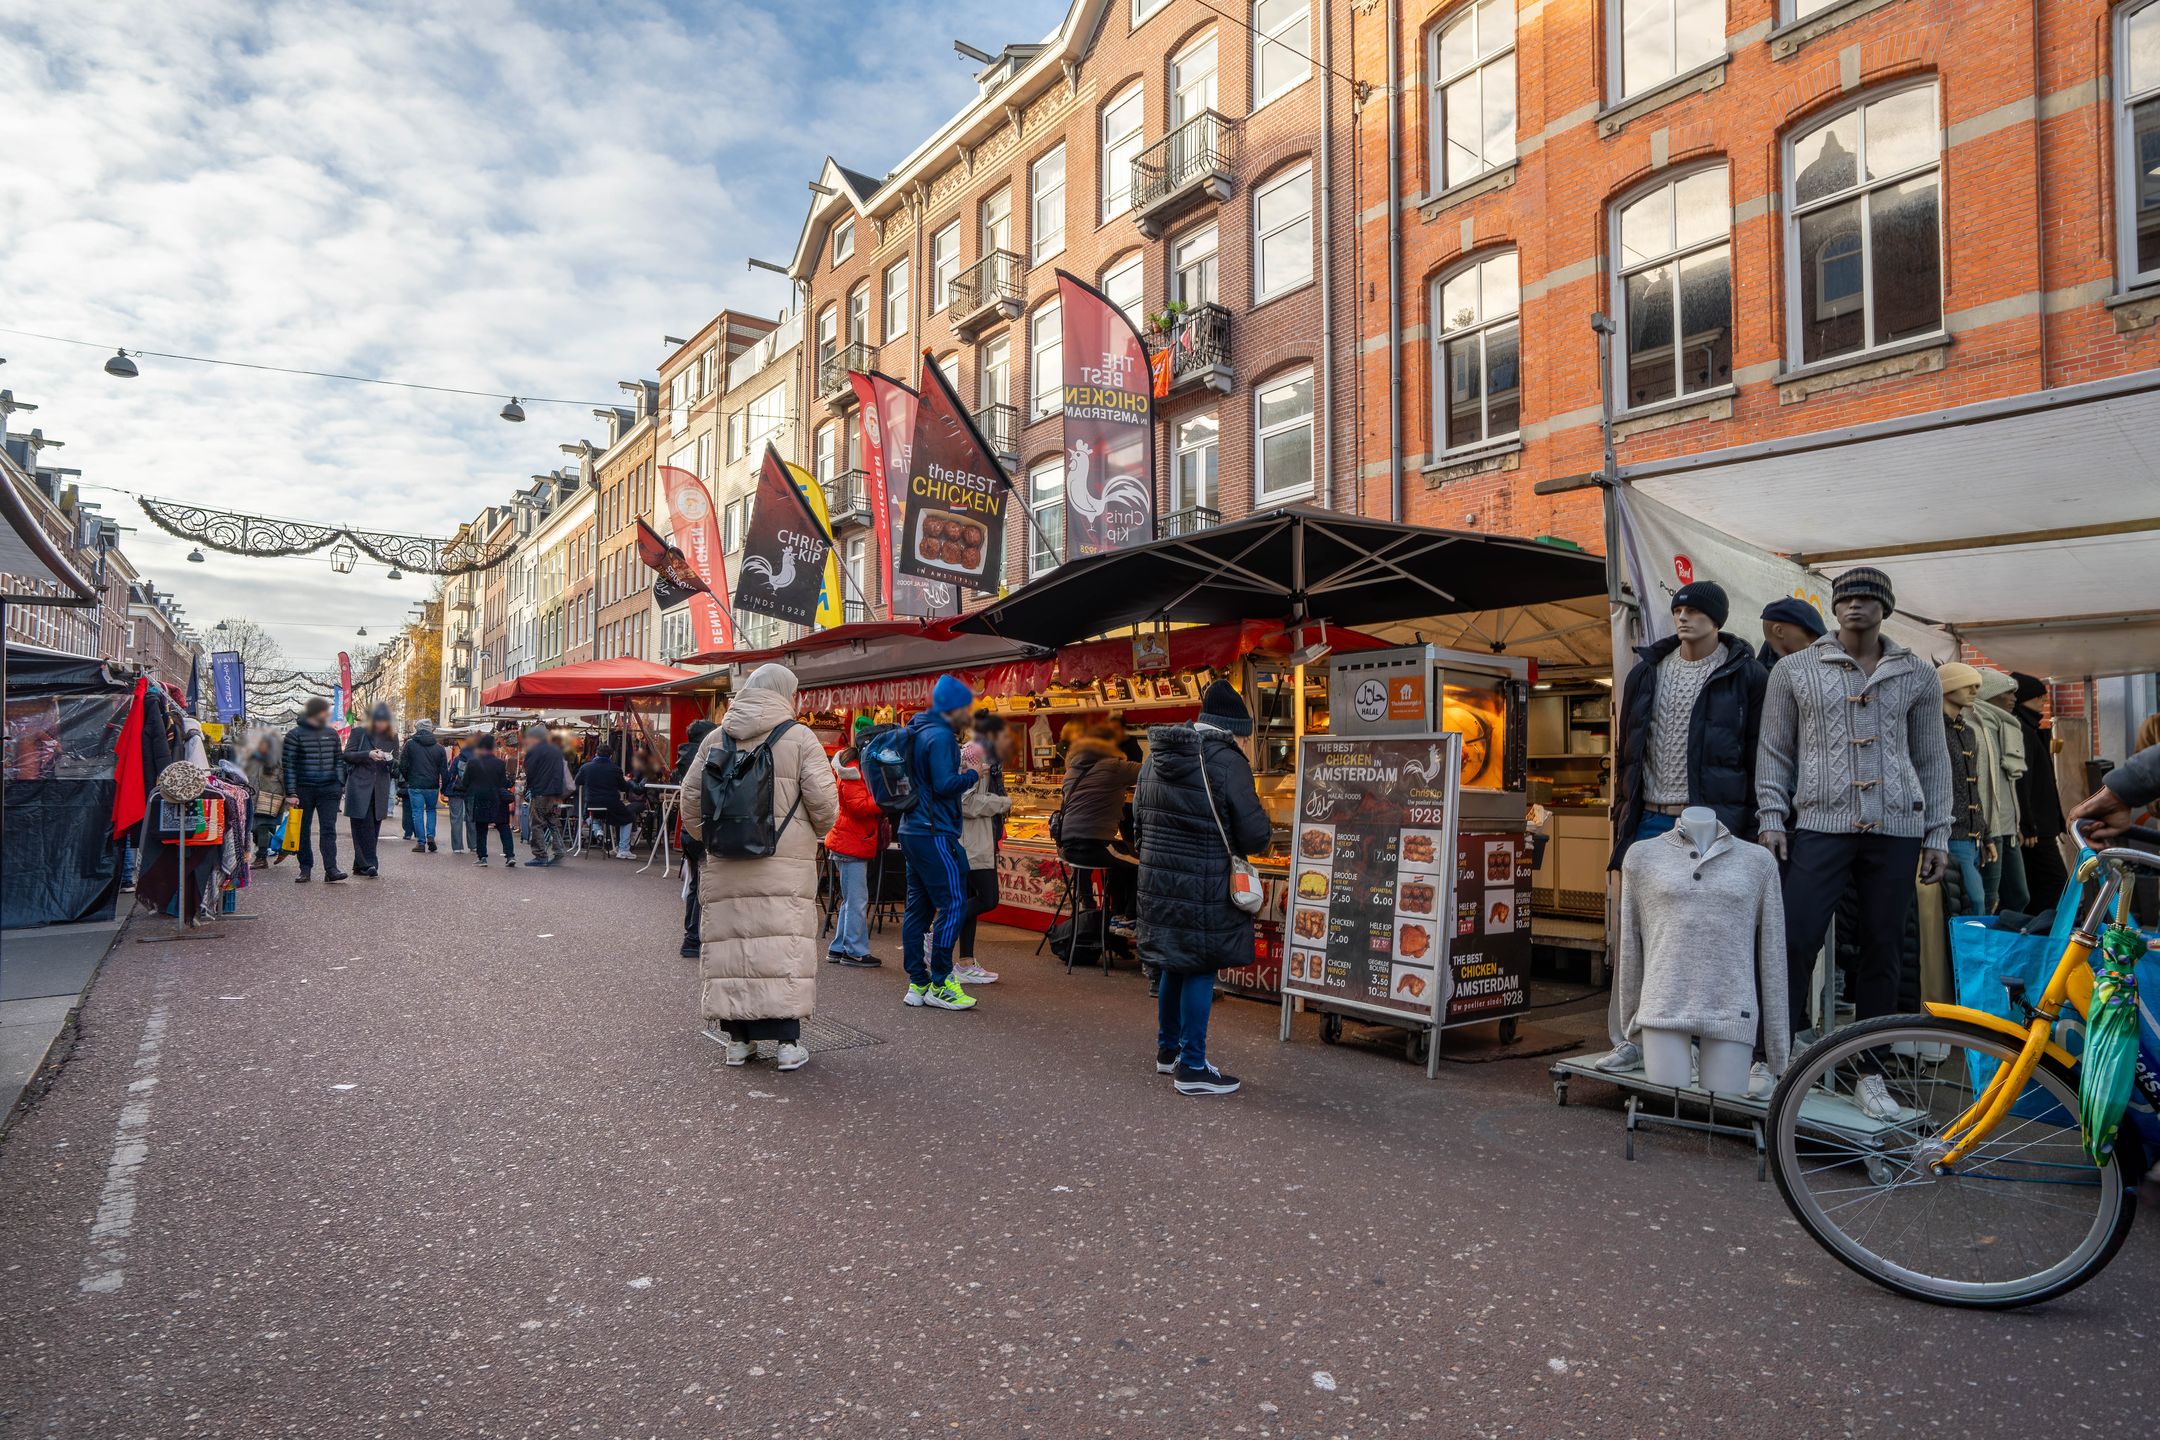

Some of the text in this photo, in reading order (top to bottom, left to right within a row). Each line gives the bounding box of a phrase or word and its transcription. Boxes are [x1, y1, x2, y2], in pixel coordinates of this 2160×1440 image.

[912, 476, 1000, 516] CHICKEN
[777, 529, 824, 553] CHRIS
[798, 549, 821, 564] KIP
[743, 594, 806, 617] SINDS 1928
[873, 678, 935, 702] AMSTERDA
[1316, 743, 1354, 753] THE BEST
[1325, 754, 1372, 766] CHICKEN
[1313, 767, 1398, 782] AMSTERDAM
[1409, 808, 1441, 823] 1928
[1336, 834, 1360, 842] BROODJE
[1335, 848, 1355, 858] 7.00
[1376, 851, 1397, 861] 7.00
[1334, 872, 1358, 880] BROODJE
[1459, 870, 1475, 879] 7.00
[1516, 866, 1531, 877] 6.00
[1331, 892, 1351, 903] 7.50
[1373, 893, 1393, 906] 6.00
[1330, 918, 1354, 927] CHICKEN
[1369, 922, 1392, 931] HELE KIP
[1329, 932, 1349, 943] 7.00
[1327, 959, 1351, 969] CHICKEN
[1453, 953, 1483, 966] THE BEST
[1327, 967, 1346, 975] WINGS
[1461, 962, 1497, 979] CHICKEN
[1327, 974, 1346, 987] 4.50
[1371, 974, 1388, 985] 3.50
[1368, 987, 1387, 997] 10.00
[1455, 975, 1519, 998] AMSTERDAM
[1502, 990, 1523, 1006] 1928
